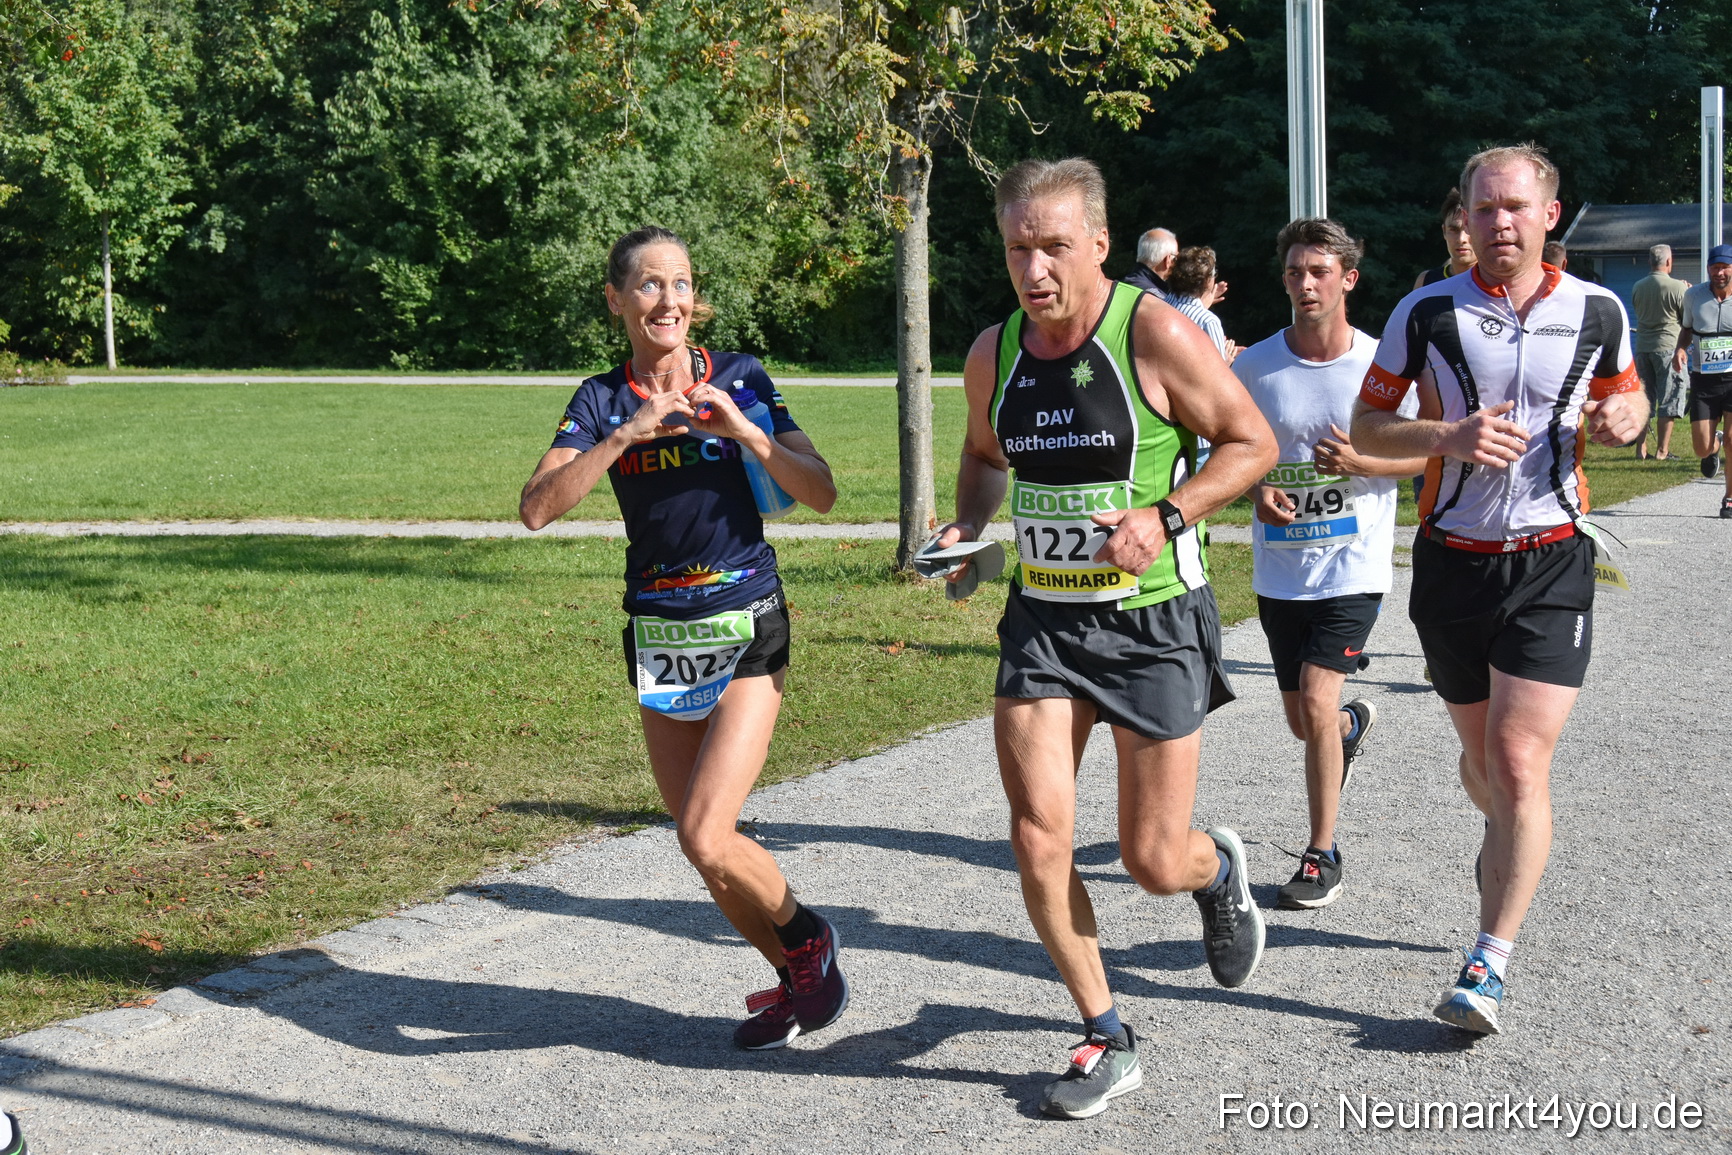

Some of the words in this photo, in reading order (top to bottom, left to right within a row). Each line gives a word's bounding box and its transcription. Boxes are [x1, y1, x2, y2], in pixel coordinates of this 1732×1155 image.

[1367, 375, 1399, 397] RAD
[1455, 363, 1475, 406] Radfreunde
[1036, 408, 1074, 427] DAV
[1005, 430, 1115, 453] Röthenbach
[618, 437, 737, 476] MENSCH
[1020, 489, 1115, 514] BOCK
[1277, 488, 1344, 519] 249
[1285, 524, 1331, 539] KEVIN
[1029, 570, 1121, 588] REINHARD
[644, 619, 738, 642] BOCK
[1574, 615, 1584, 648] adidas
[671, 685, 720, 709] GISELA
